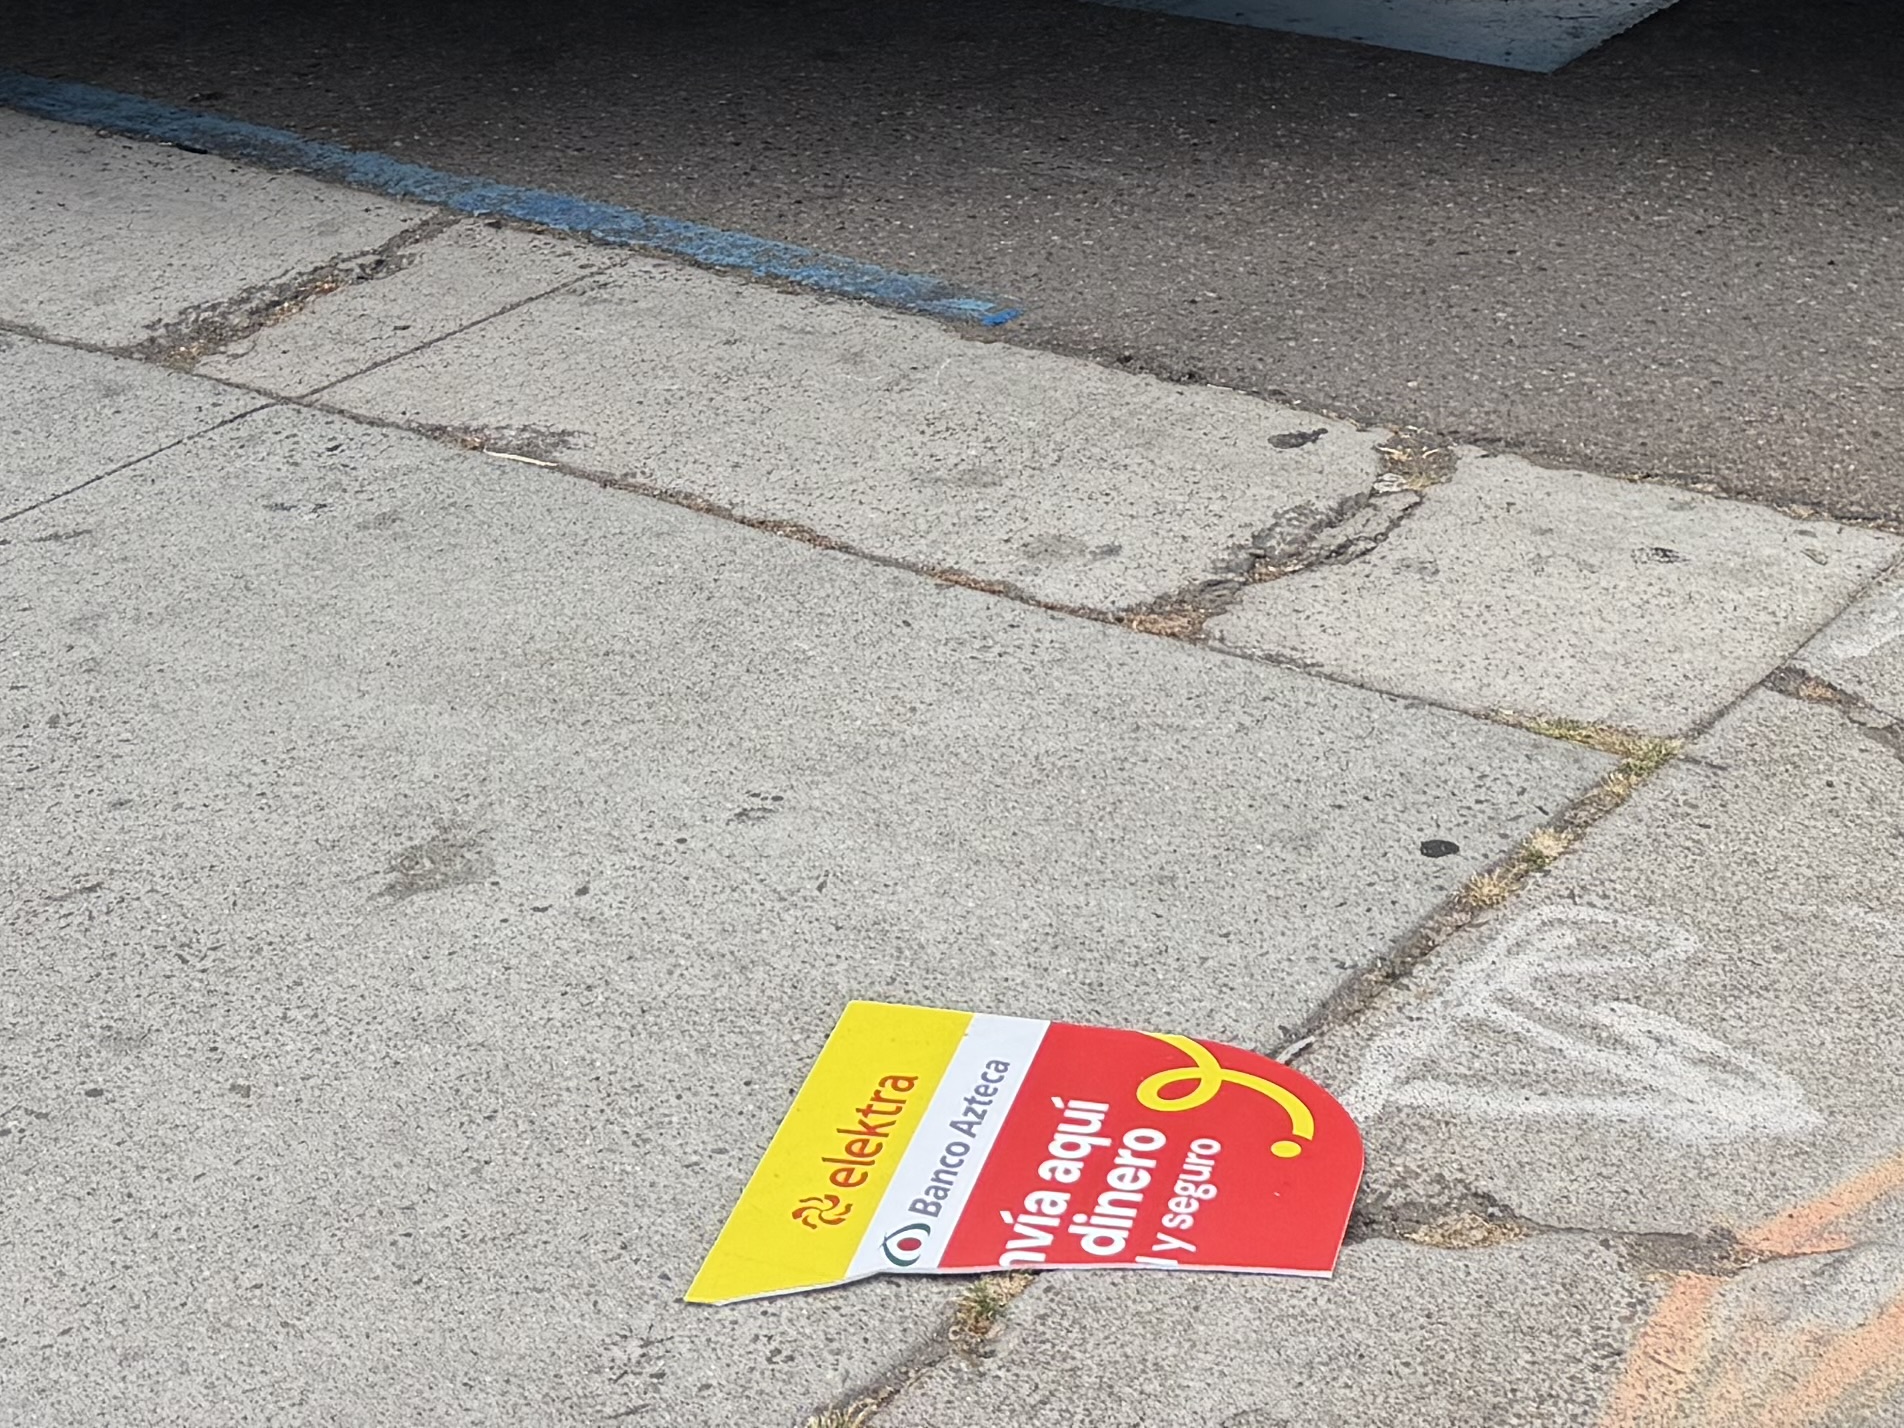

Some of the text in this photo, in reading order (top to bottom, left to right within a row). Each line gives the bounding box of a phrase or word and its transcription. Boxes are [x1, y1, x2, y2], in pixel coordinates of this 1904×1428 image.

[828, 1072, 920, 1189] elektra
[908, 1058, 1012, 1219] Banco Azteca
[1037, 1096, 1112, 1184] aquí
[1068, 1127, 1167, 1256] dinero
[1161, 1138, 1222, 1230] seguro
[1151, 1232, 1197, 1253] y
